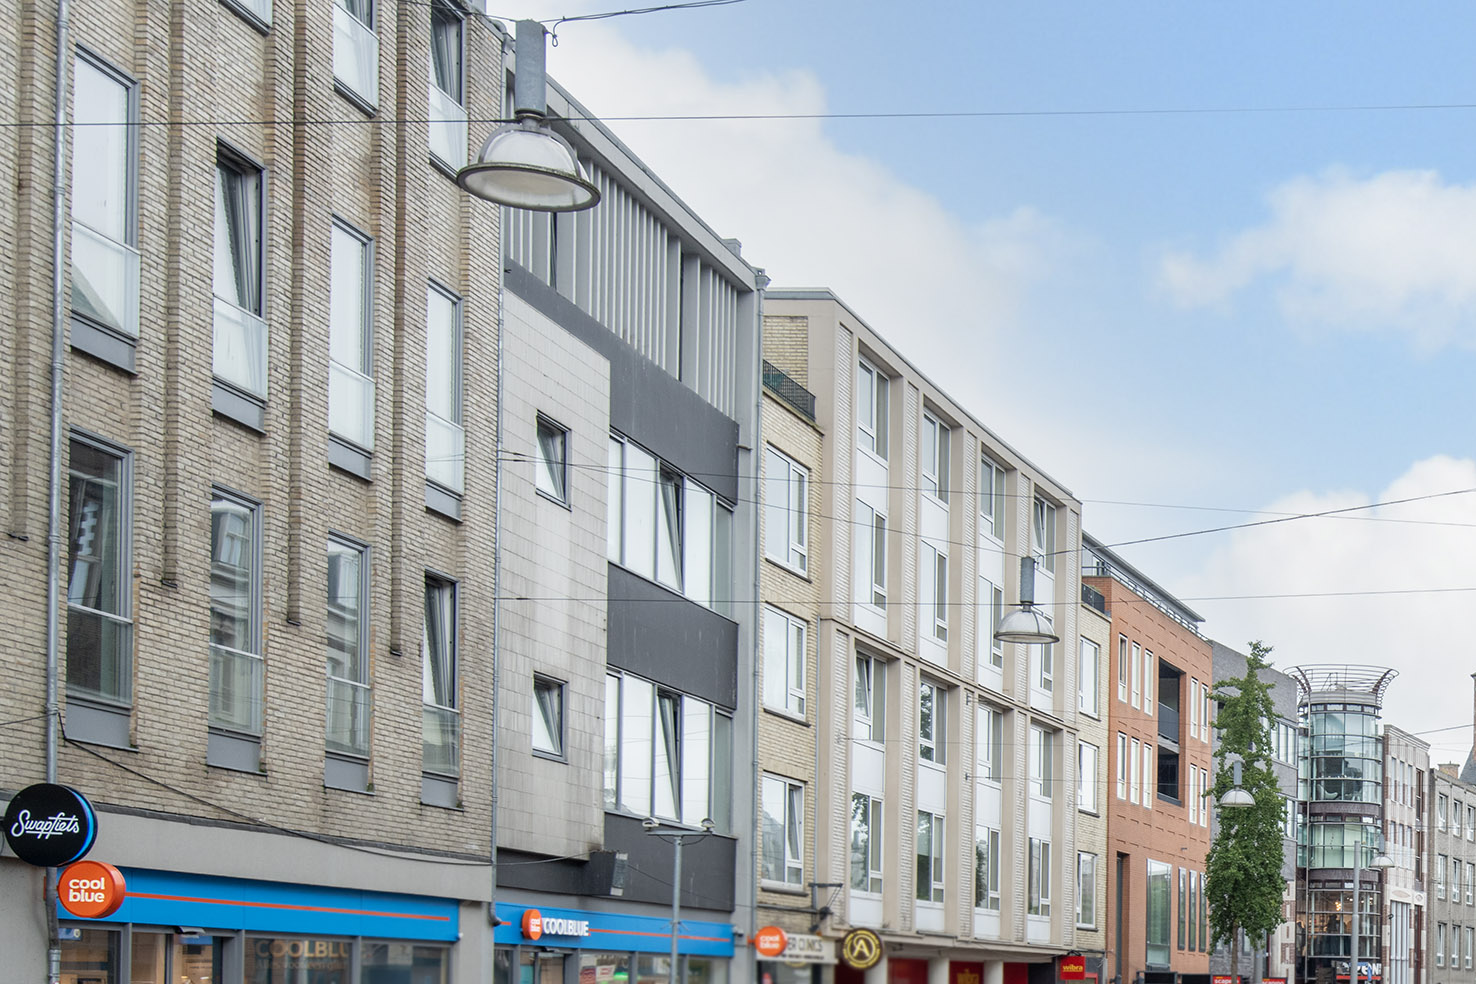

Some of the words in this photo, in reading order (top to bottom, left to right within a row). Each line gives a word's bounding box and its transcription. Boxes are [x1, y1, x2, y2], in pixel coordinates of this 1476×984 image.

[11, 809, 80, 840] Swapfiets
[68, 877, 105, 890] cool
[68, 889, 105, 903] blue
[543, 917, 589, 936] COOLBLUE
[1062, 963, 1083, 971] wibra
